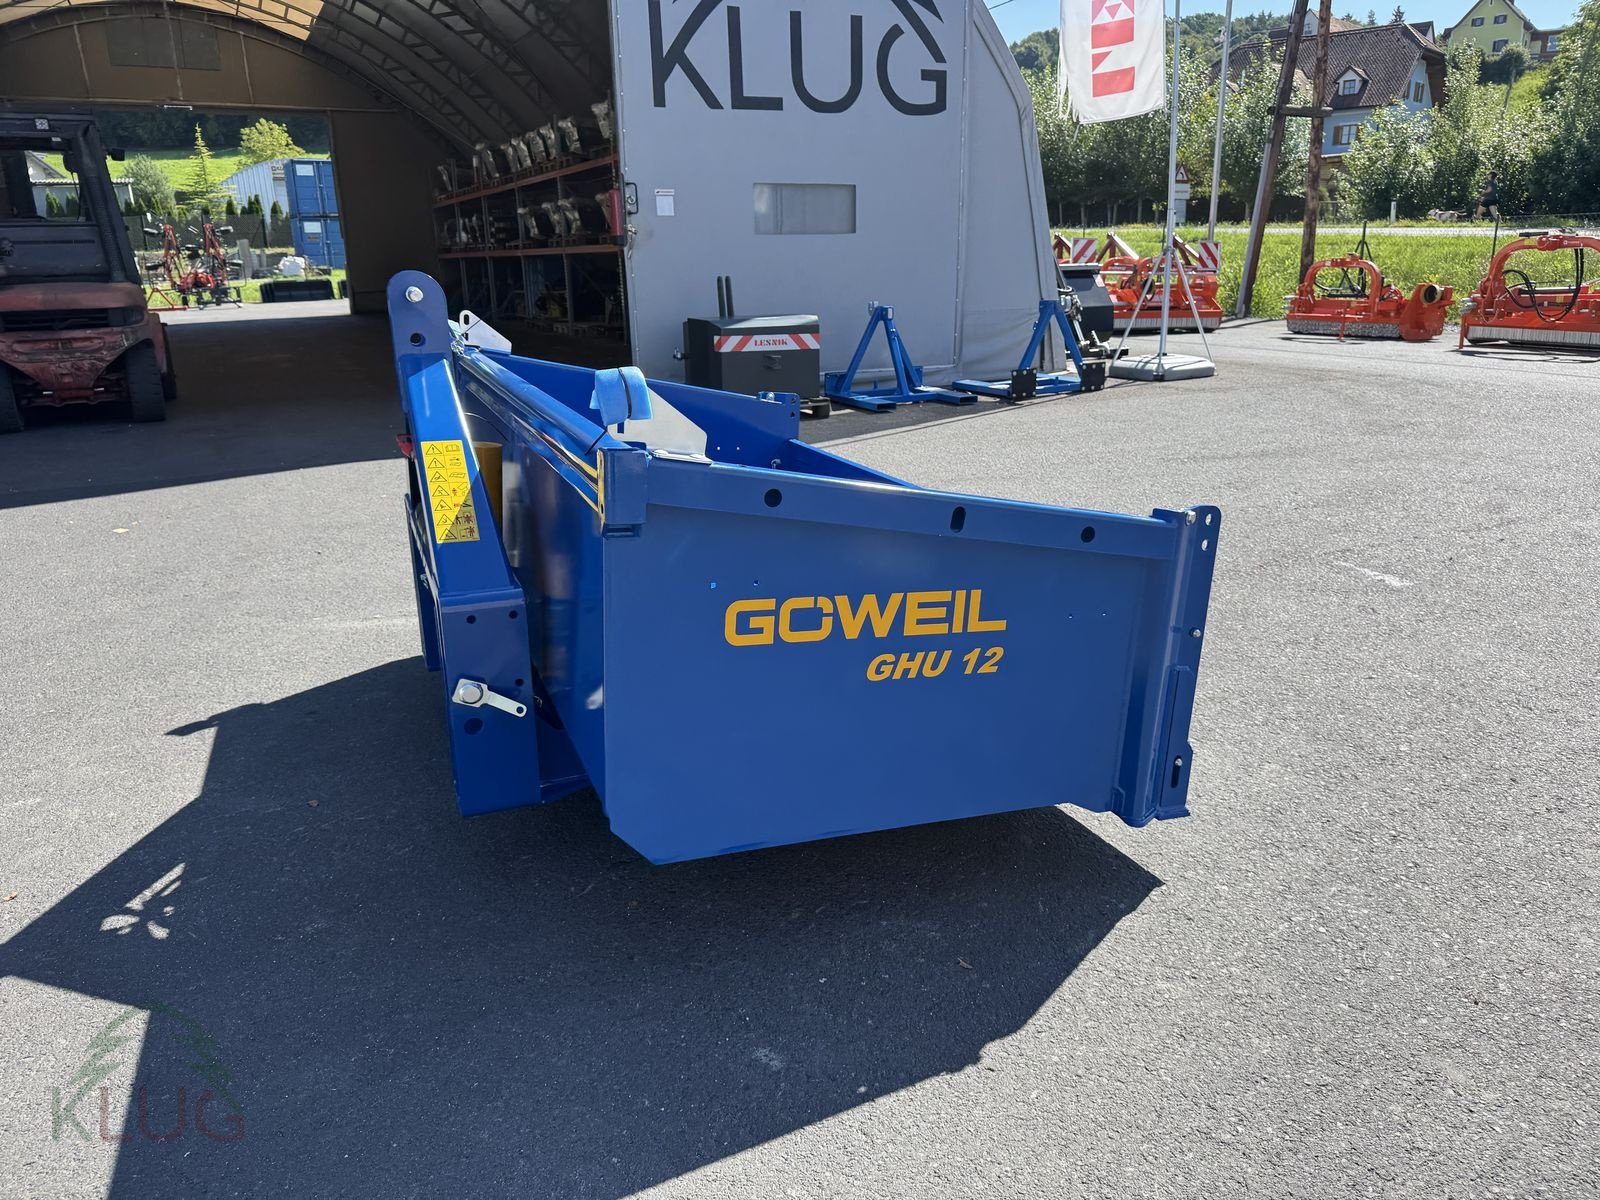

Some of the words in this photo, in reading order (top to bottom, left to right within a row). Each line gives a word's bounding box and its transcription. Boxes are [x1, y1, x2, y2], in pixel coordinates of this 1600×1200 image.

[648, 0, 947, 116] KLUG
[866, 650, 952, 682] GHU
[962, 646, 1004, 675] 12
